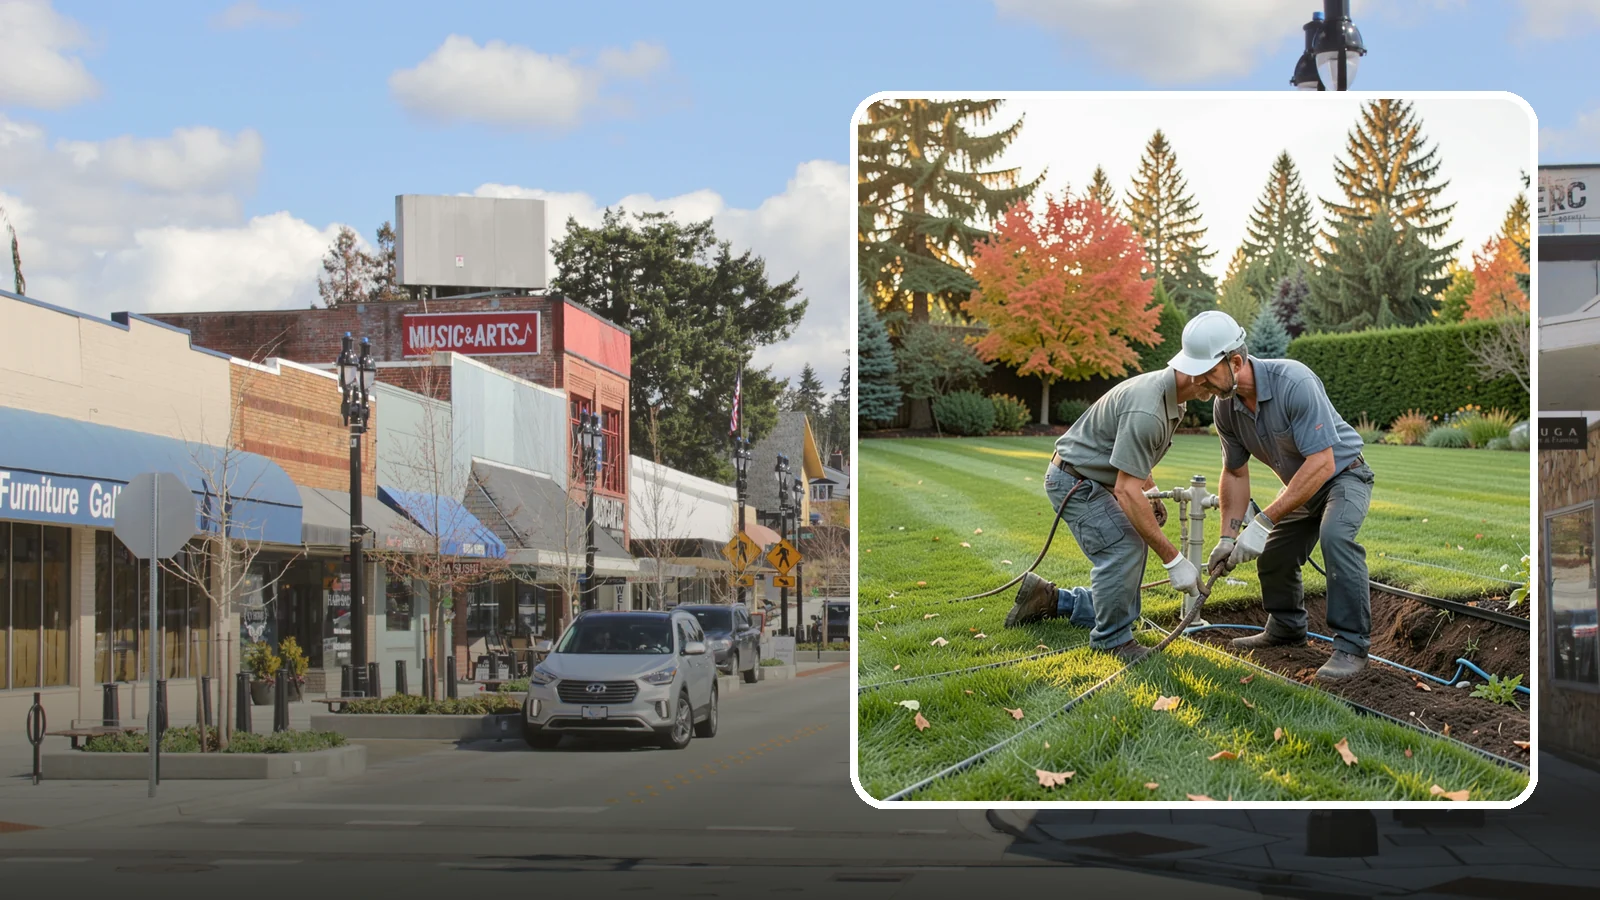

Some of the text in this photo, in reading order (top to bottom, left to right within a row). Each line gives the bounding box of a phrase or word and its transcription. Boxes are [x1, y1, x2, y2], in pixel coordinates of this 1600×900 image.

[0, 471, 120, 519] Furniture Gal
[453, 563, 479, 574] SUSHI
